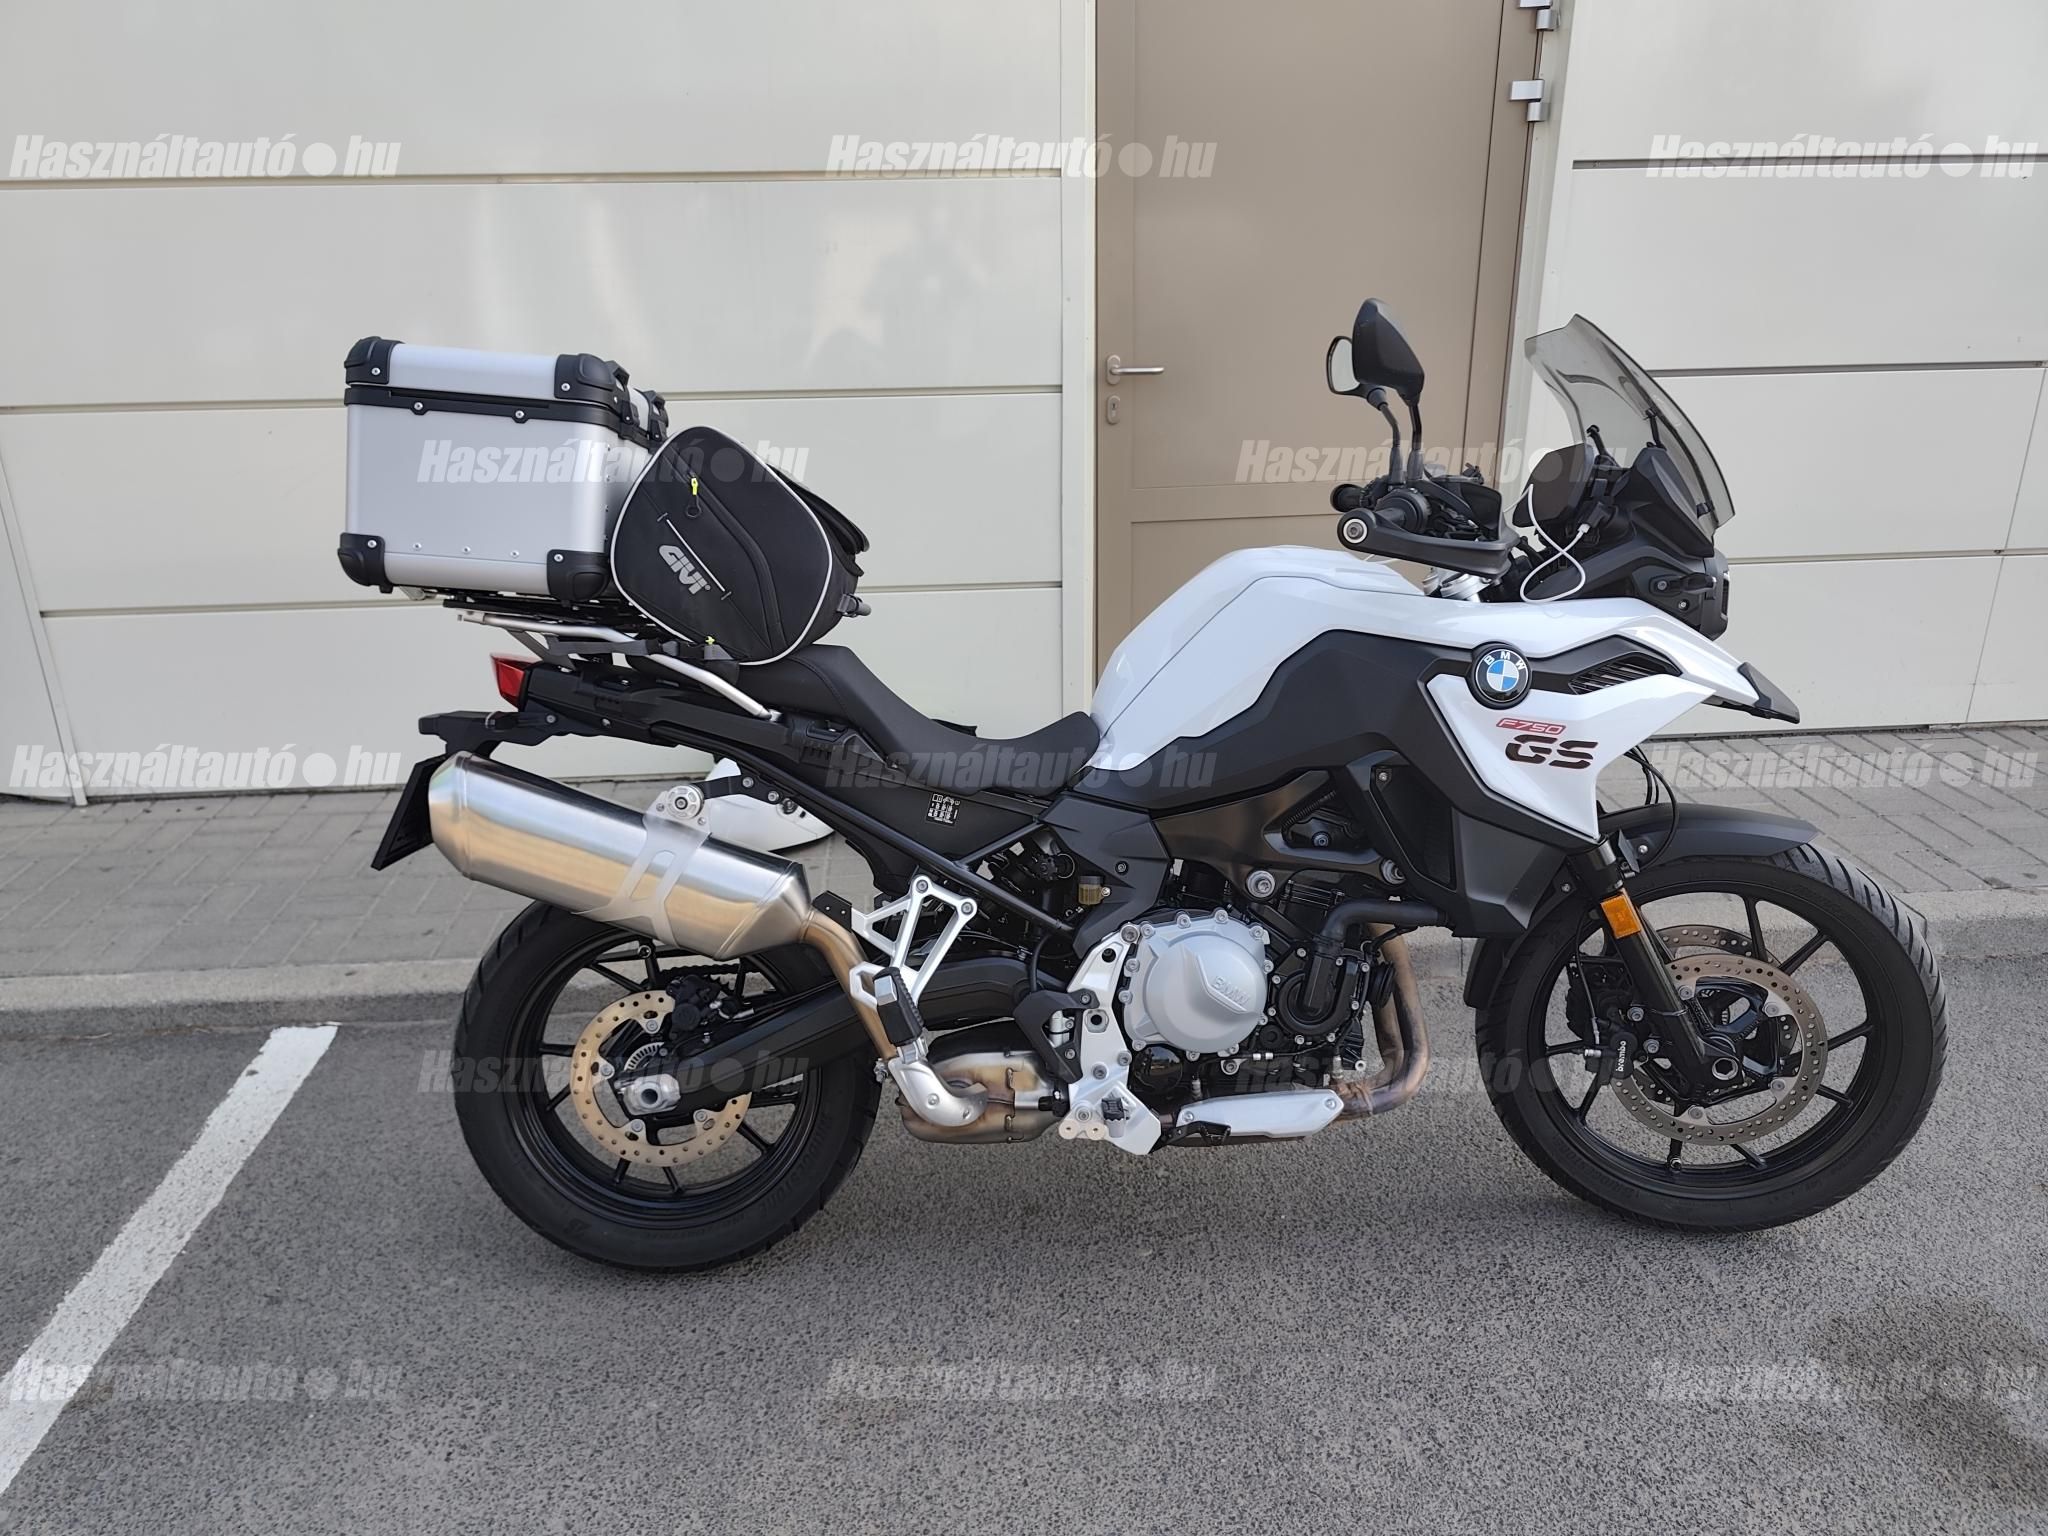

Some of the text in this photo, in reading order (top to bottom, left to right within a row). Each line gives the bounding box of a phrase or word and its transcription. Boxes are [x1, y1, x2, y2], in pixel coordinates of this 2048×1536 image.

[659, 545, 706, 594] GIVI
[1484, 651, 1527, 671] BMW
[1498, 719, 1564, 734] F750
[1505, 734, 1598, 769] GS
[1615, 1040, 1627, 1072] brembo
